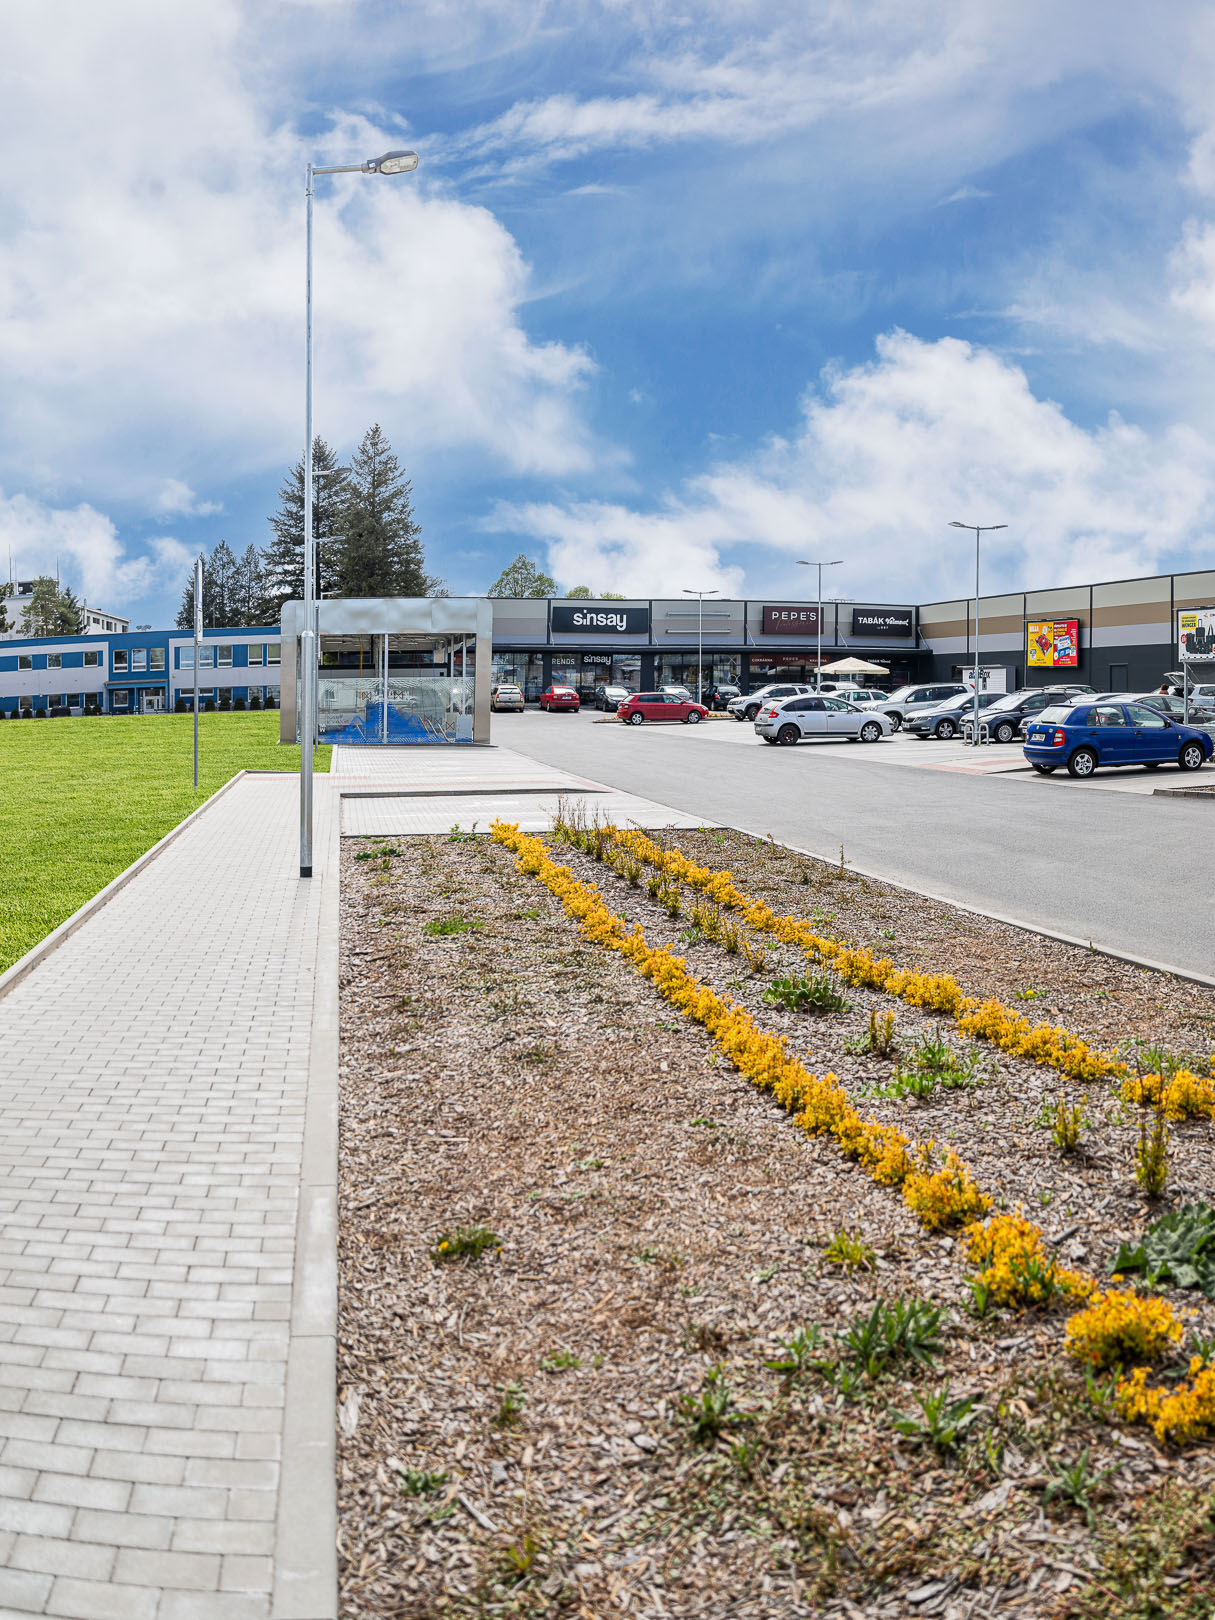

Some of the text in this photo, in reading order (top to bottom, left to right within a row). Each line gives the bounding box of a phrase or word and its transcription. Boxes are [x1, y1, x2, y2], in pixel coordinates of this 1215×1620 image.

[573, 609, 627, 631] sinsay
[772, 610, 817, 621] PEPE'S
[857, 616, 885, 625] TABÁK
[583, 654, 611, 665] sinsay
